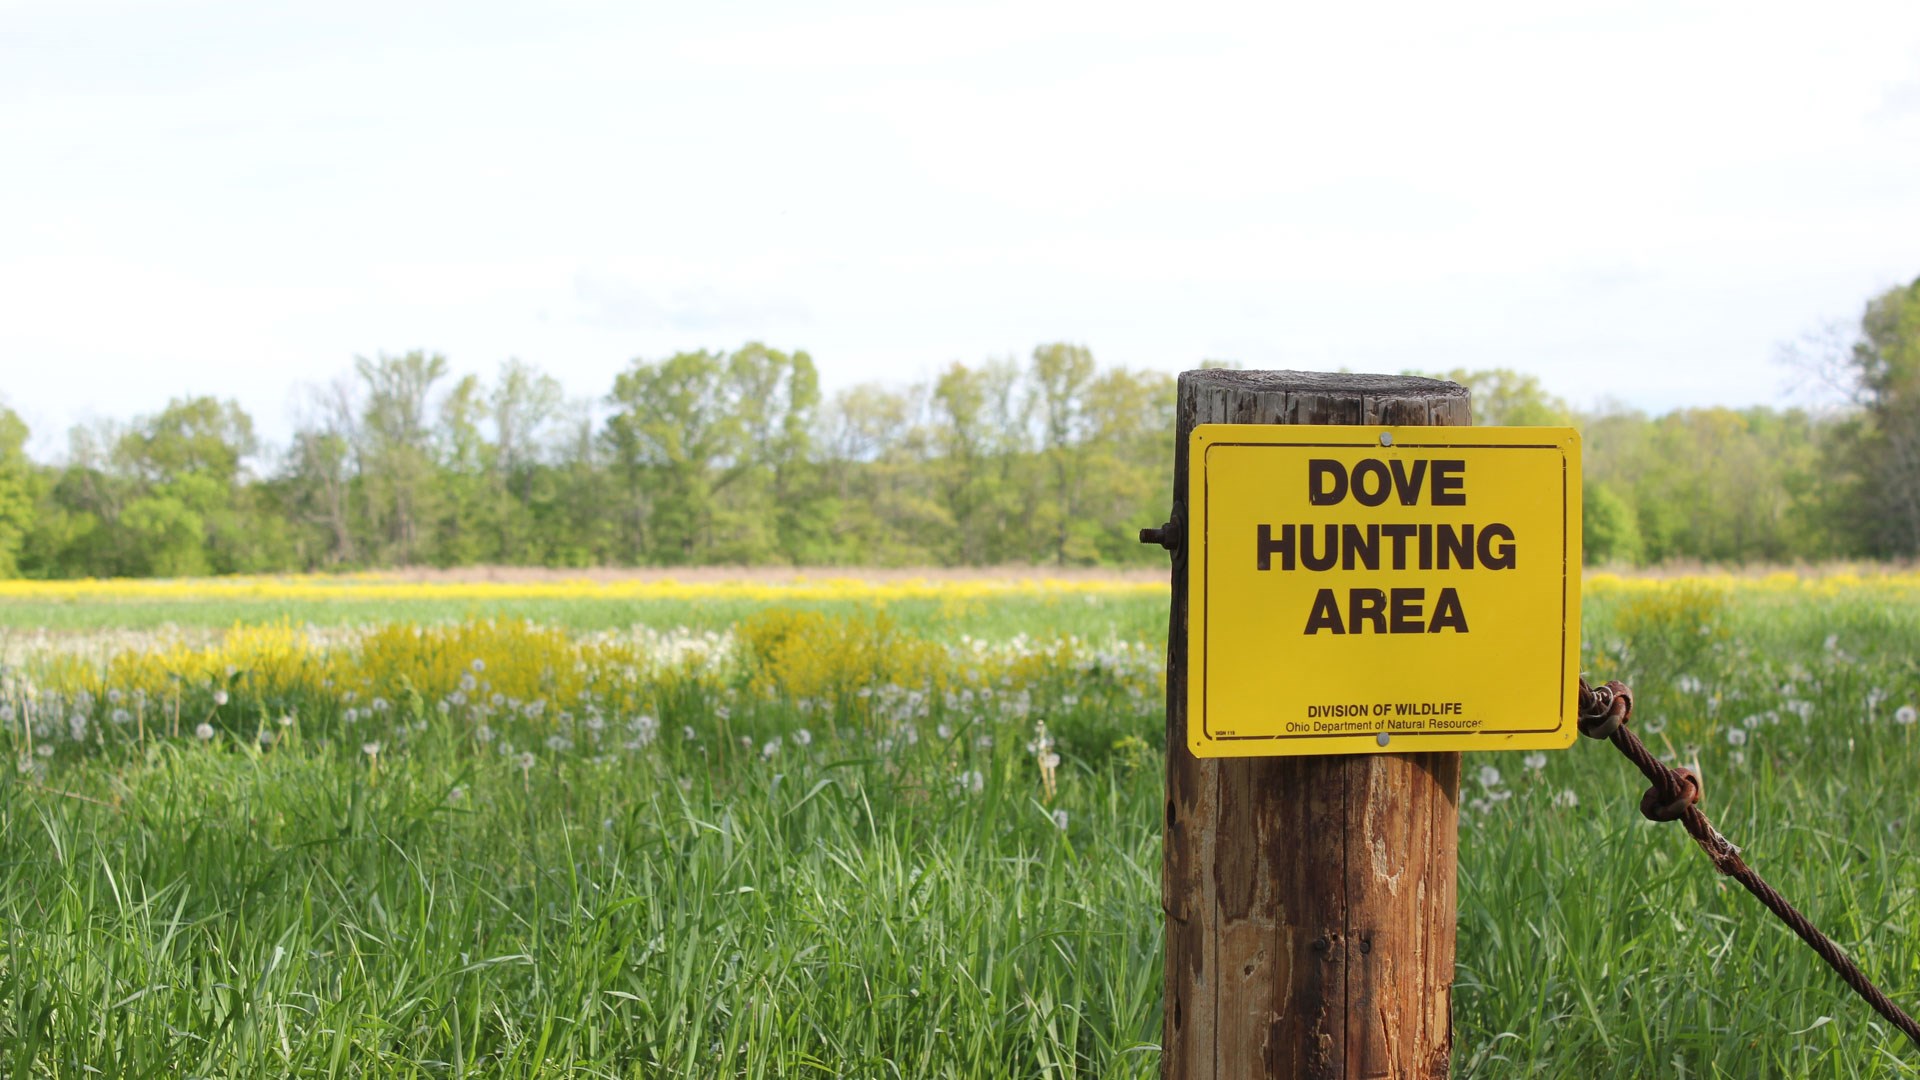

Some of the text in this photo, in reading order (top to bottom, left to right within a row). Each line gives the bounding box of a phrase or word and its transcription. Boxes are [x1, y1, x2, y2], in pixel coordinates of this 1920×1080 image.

[1308, 458, 1467, 507] DOVE
[1256, 522, 1517, 572] HUNTING
[1303, 587, 1470, 635] AREA
[1285, 721, 1310, 733] Ohio
[1313, 720, 1372, 734] Department
[1374, 719, 1386, 730] of
[1387, 719, 1426, 730] Natural
[1307, 702, 1464, 718] DIVISION OF WILDLIFE
